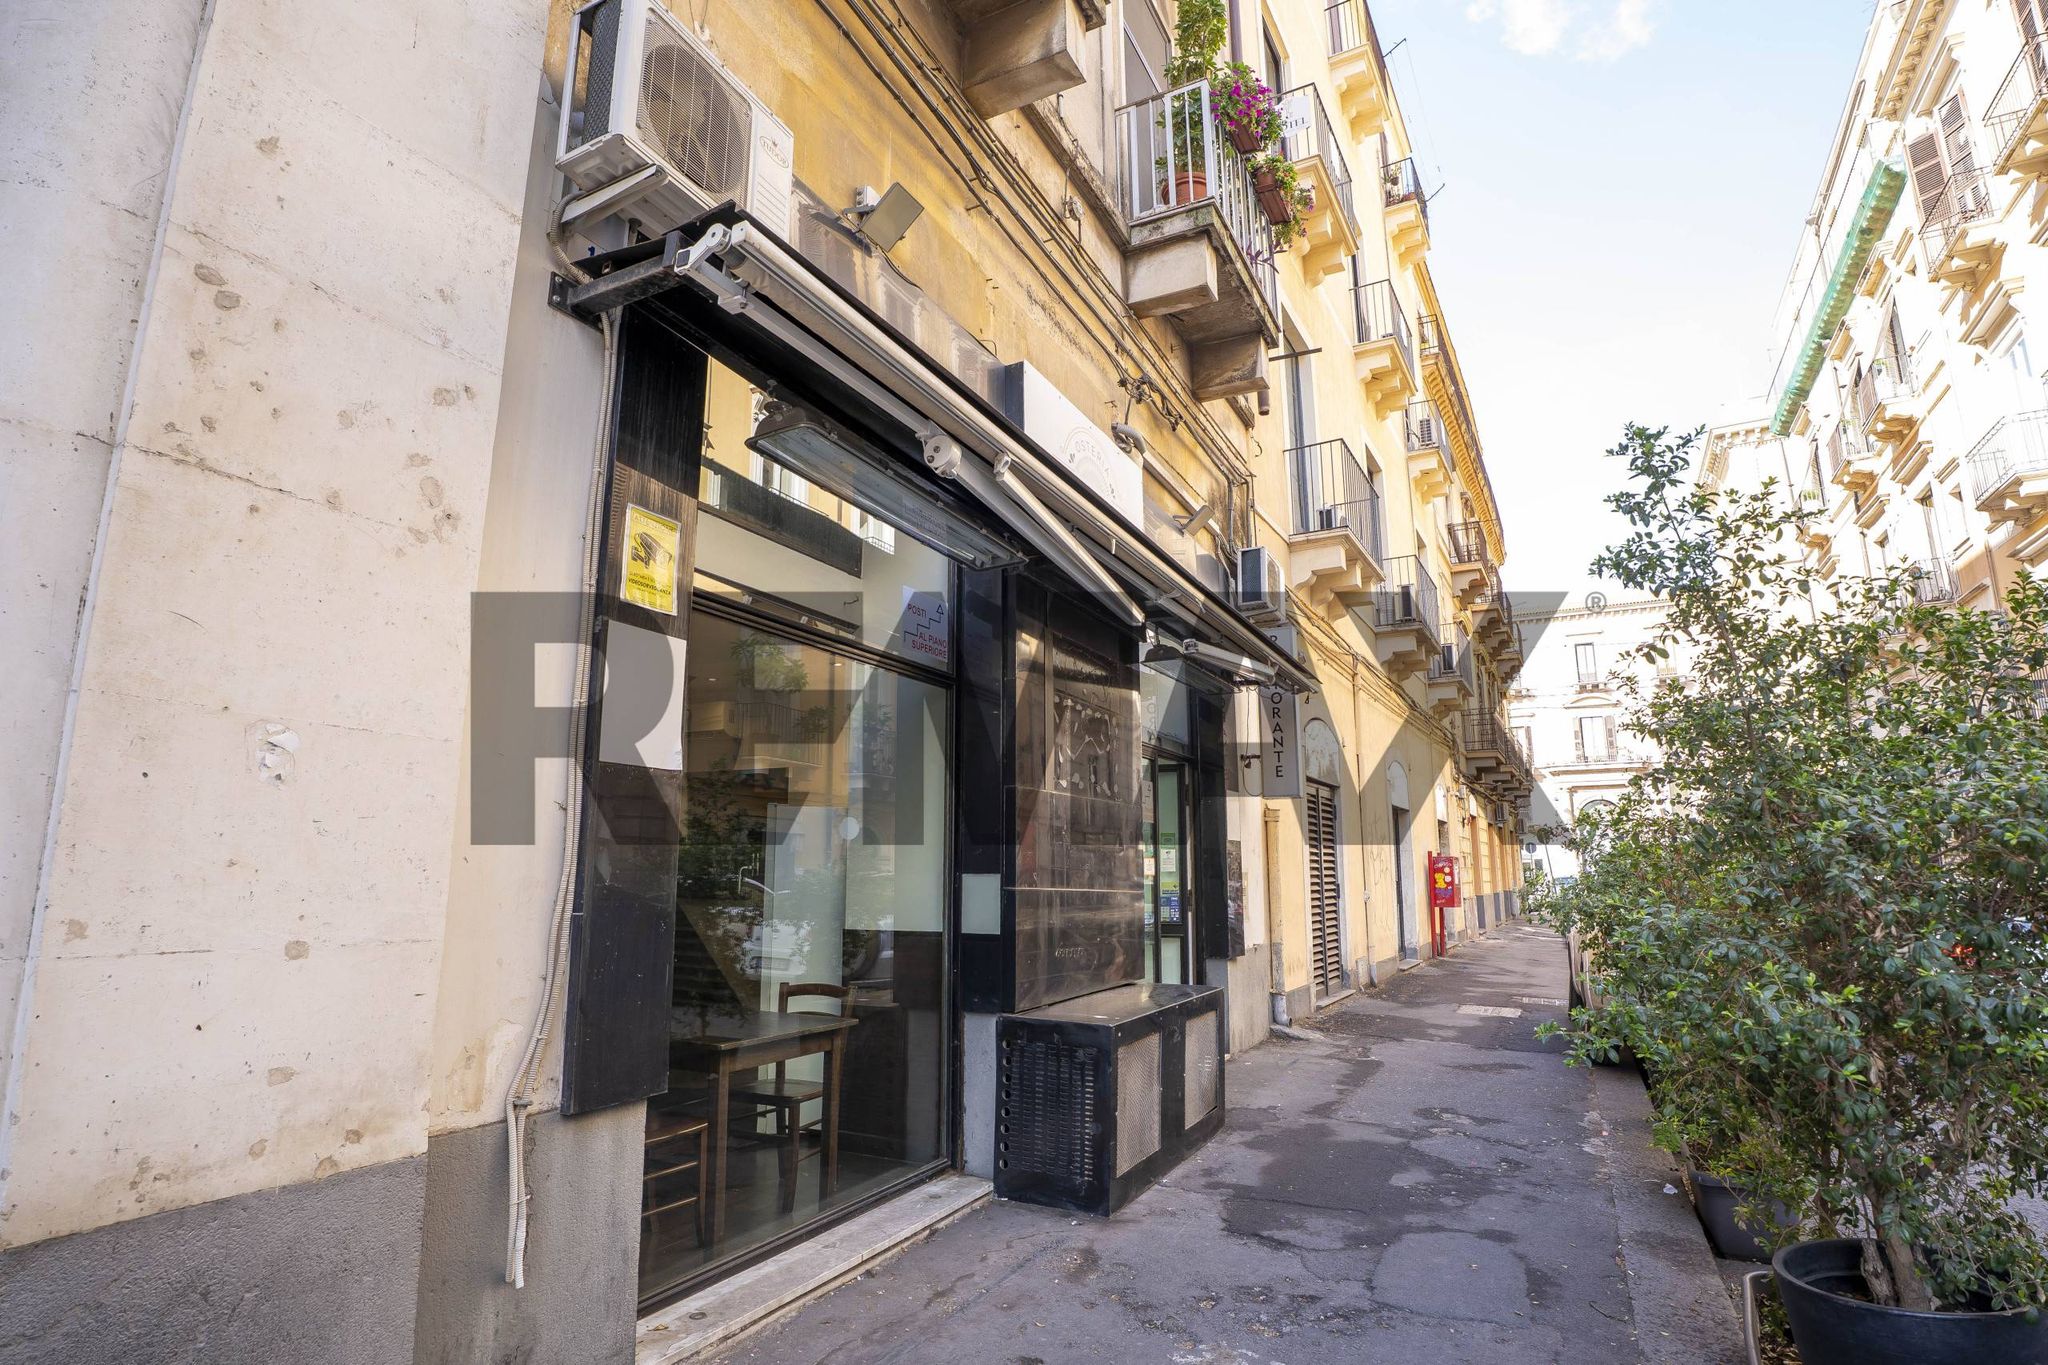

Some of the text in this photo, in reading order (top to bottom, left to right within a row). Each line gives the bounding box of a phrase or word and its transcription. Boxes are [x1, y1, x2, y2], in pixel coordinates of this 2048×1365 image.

[907, 603, 927, 619] POSTI
[918, 632, 947, 649] AL PIANO
[911, 640, 947, 659] SUPERIORE
